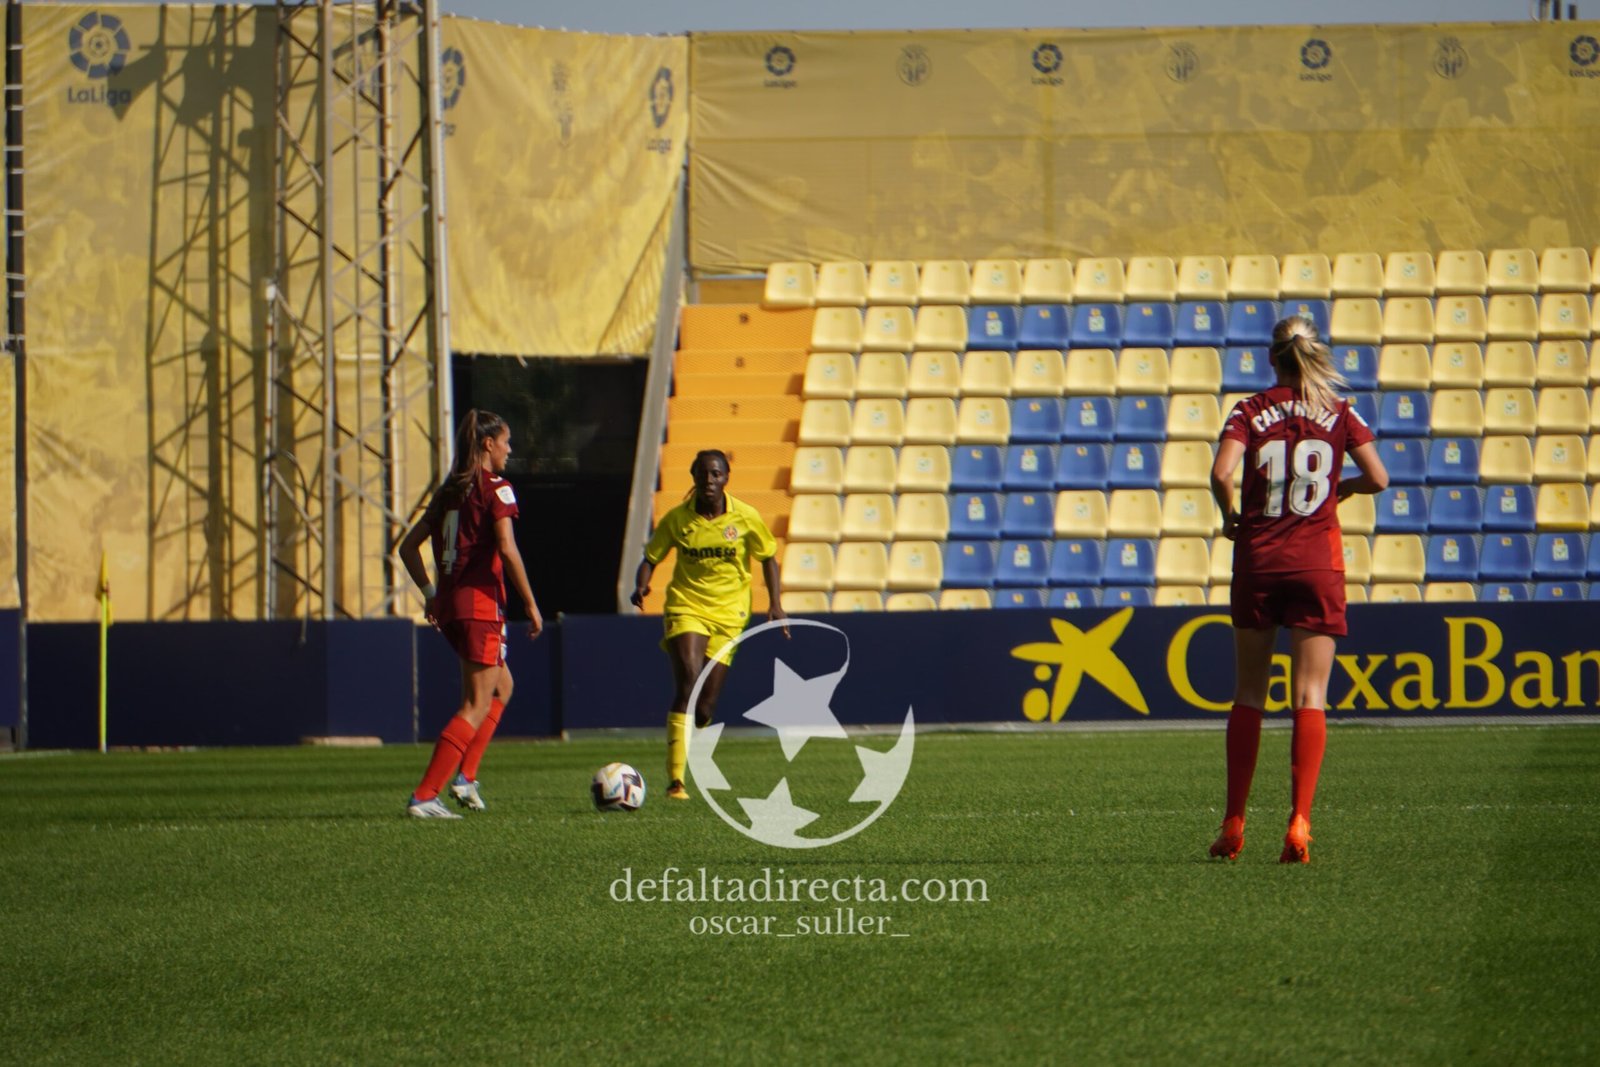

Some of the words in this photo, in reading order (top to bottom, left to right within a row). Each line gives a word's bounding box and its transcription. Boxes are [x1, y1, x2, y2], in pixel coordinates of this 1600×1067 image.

[68, 86, 131, 107] LaLiga
[1256, 438, 1333, 517] 18
[1166, 614, 1600, 712] CaxaBan
